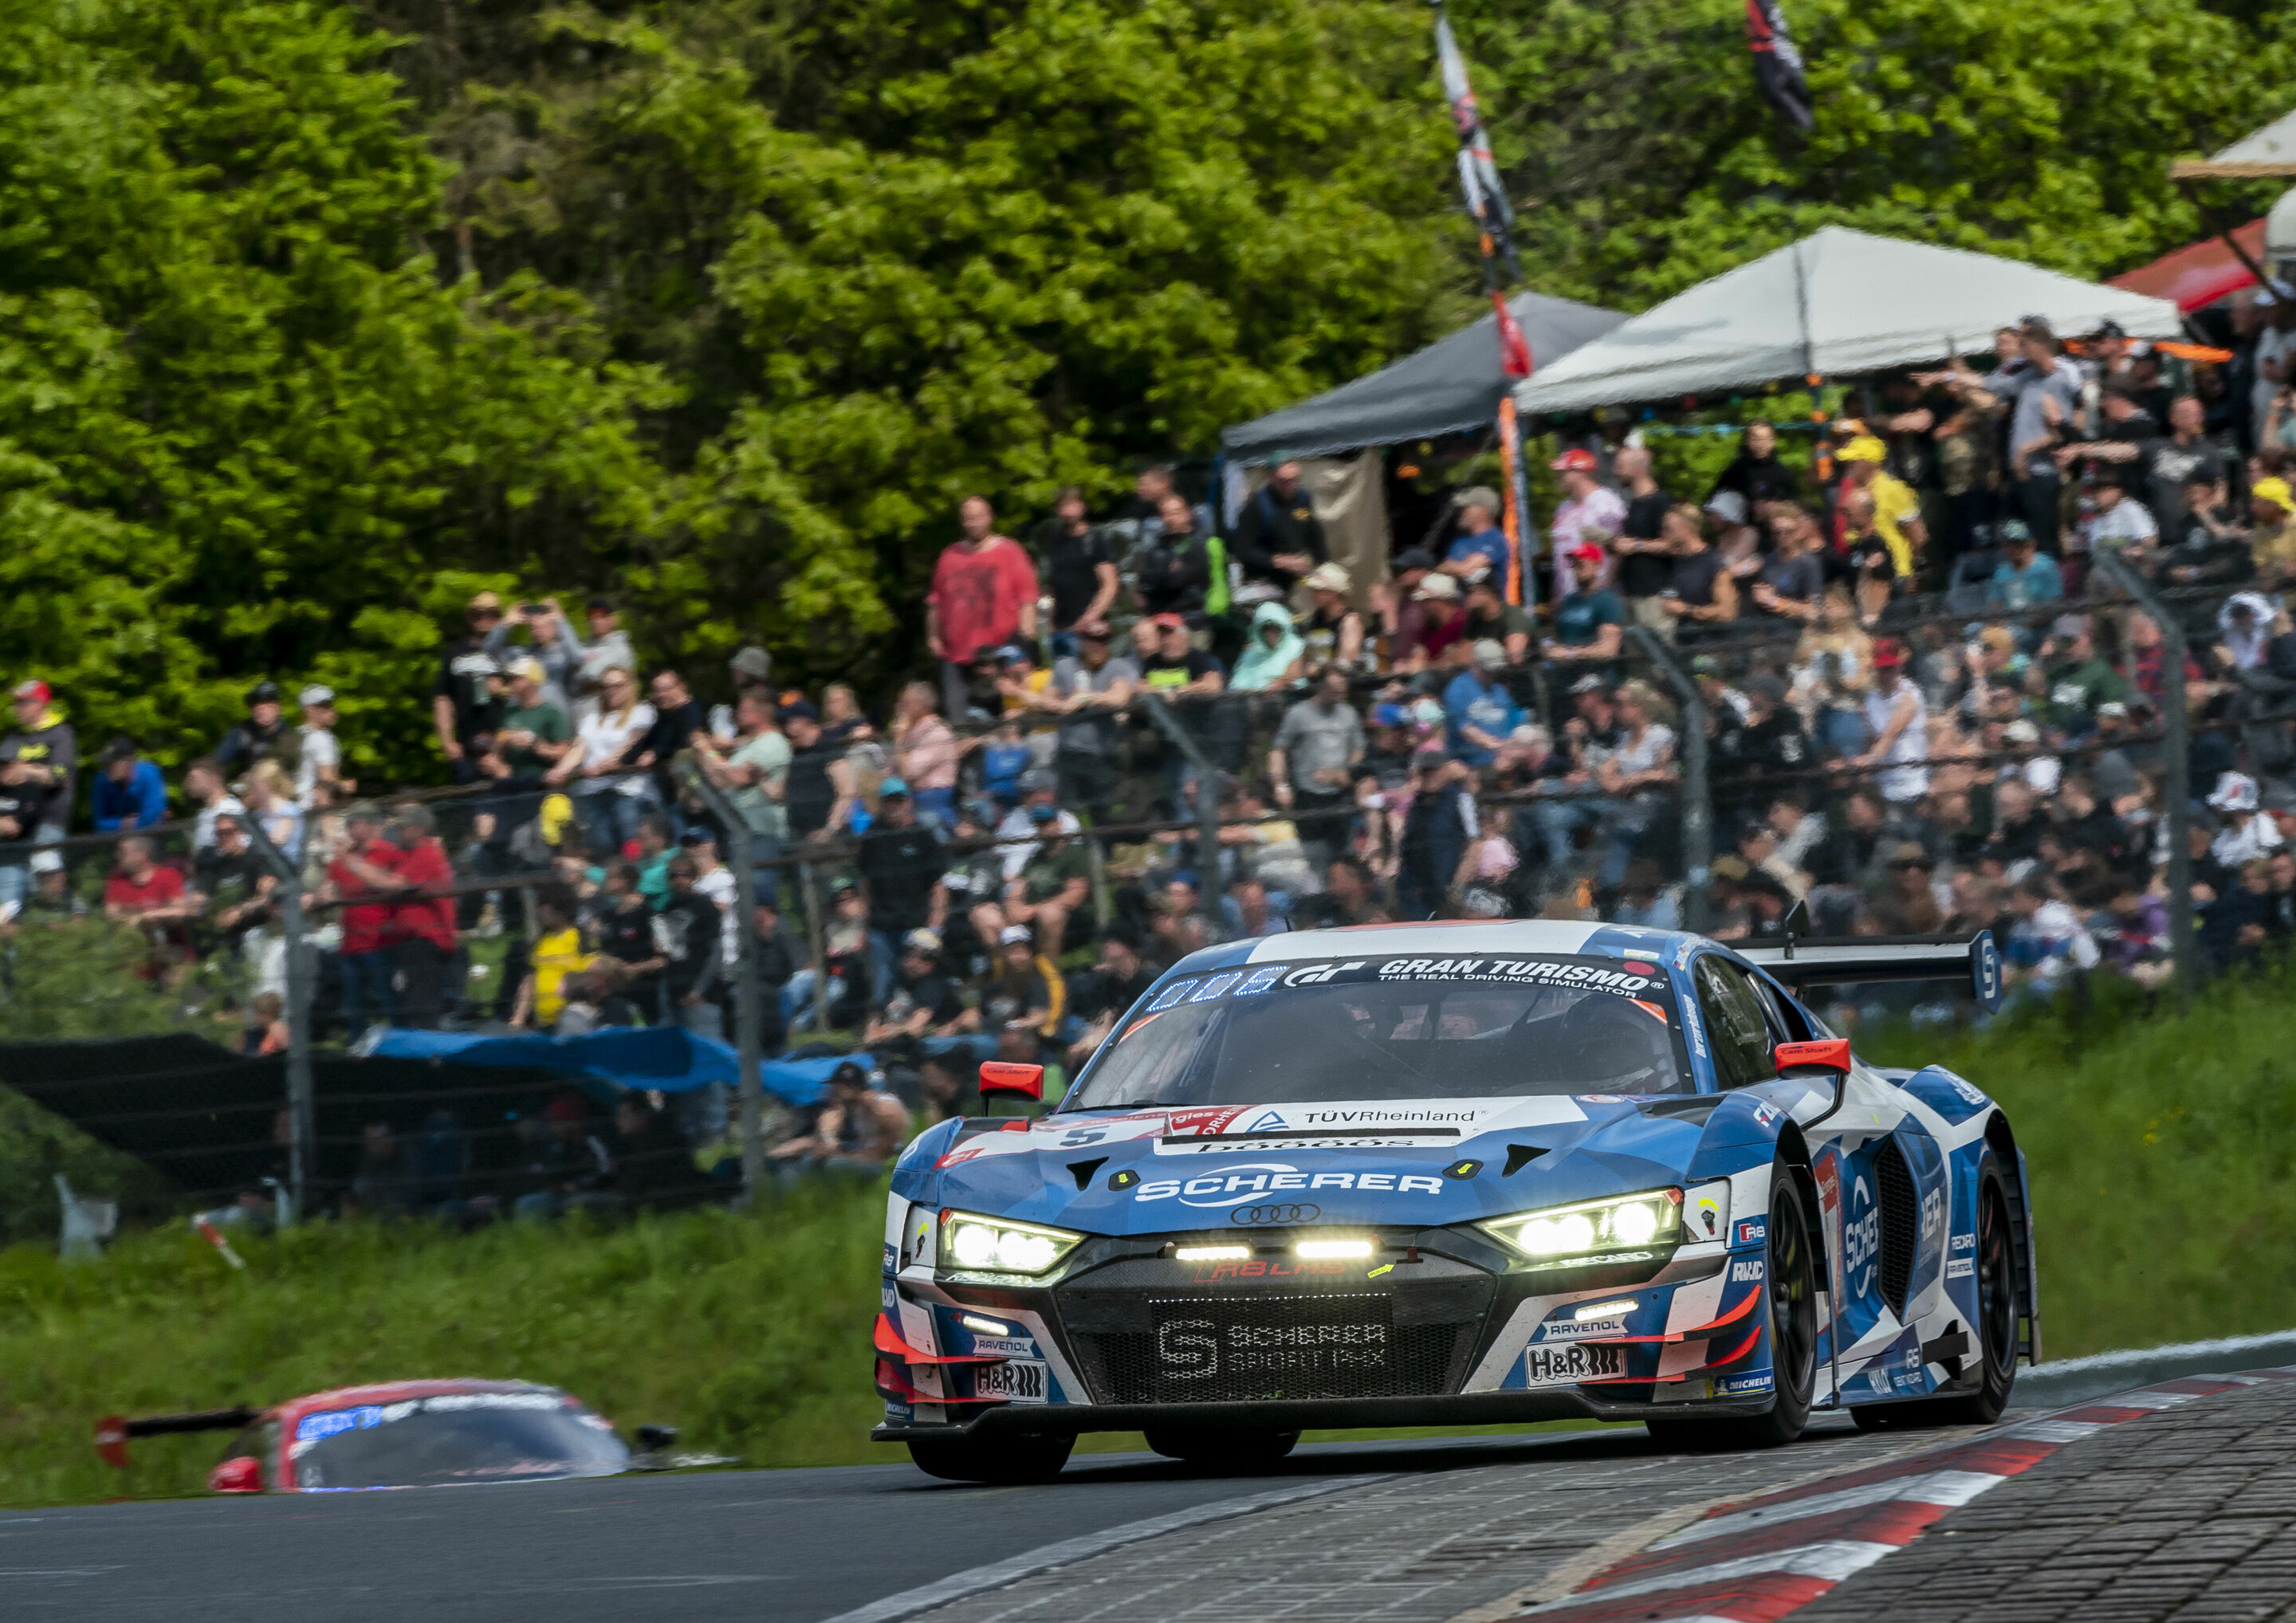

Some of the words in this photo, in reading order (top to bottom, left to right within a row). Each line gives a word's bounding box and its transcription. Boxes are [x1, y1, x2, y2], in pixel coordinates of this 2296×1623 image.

[1378, 958, 1486, 974] GRAN
[1488, 961, 1649, 992] TURISMO
[1462, 974, 1534, 983] DRIVING
[1538, 977, 1637, 999] SIMULATOR
[1305, 1110, 1475, 1123] TÜVRheinland
[1060, 1125, 1111, 1147] 5
[1134, 1173, 1444, 1202] SCHERER
[1559, 1251, 1653, 1268] RECARO
[1211, 1261, 1268, 1278] R8
[1269, 1262, 1347, 1276] LMS
[1229, 1324, 1386, 1346] SCHERER
[1551, 1319, 1620, 1335] RAVENOL
[978, 1340, 1028, 1352] RAVENOL
[1530, 1346, 1590, 1381] H&R
[977, 1364, 1020, 1395] H&R
[1729, 1375, 1772, 1390] MICHELIN
[886, 1404, 911, 1415] MICHELIN
